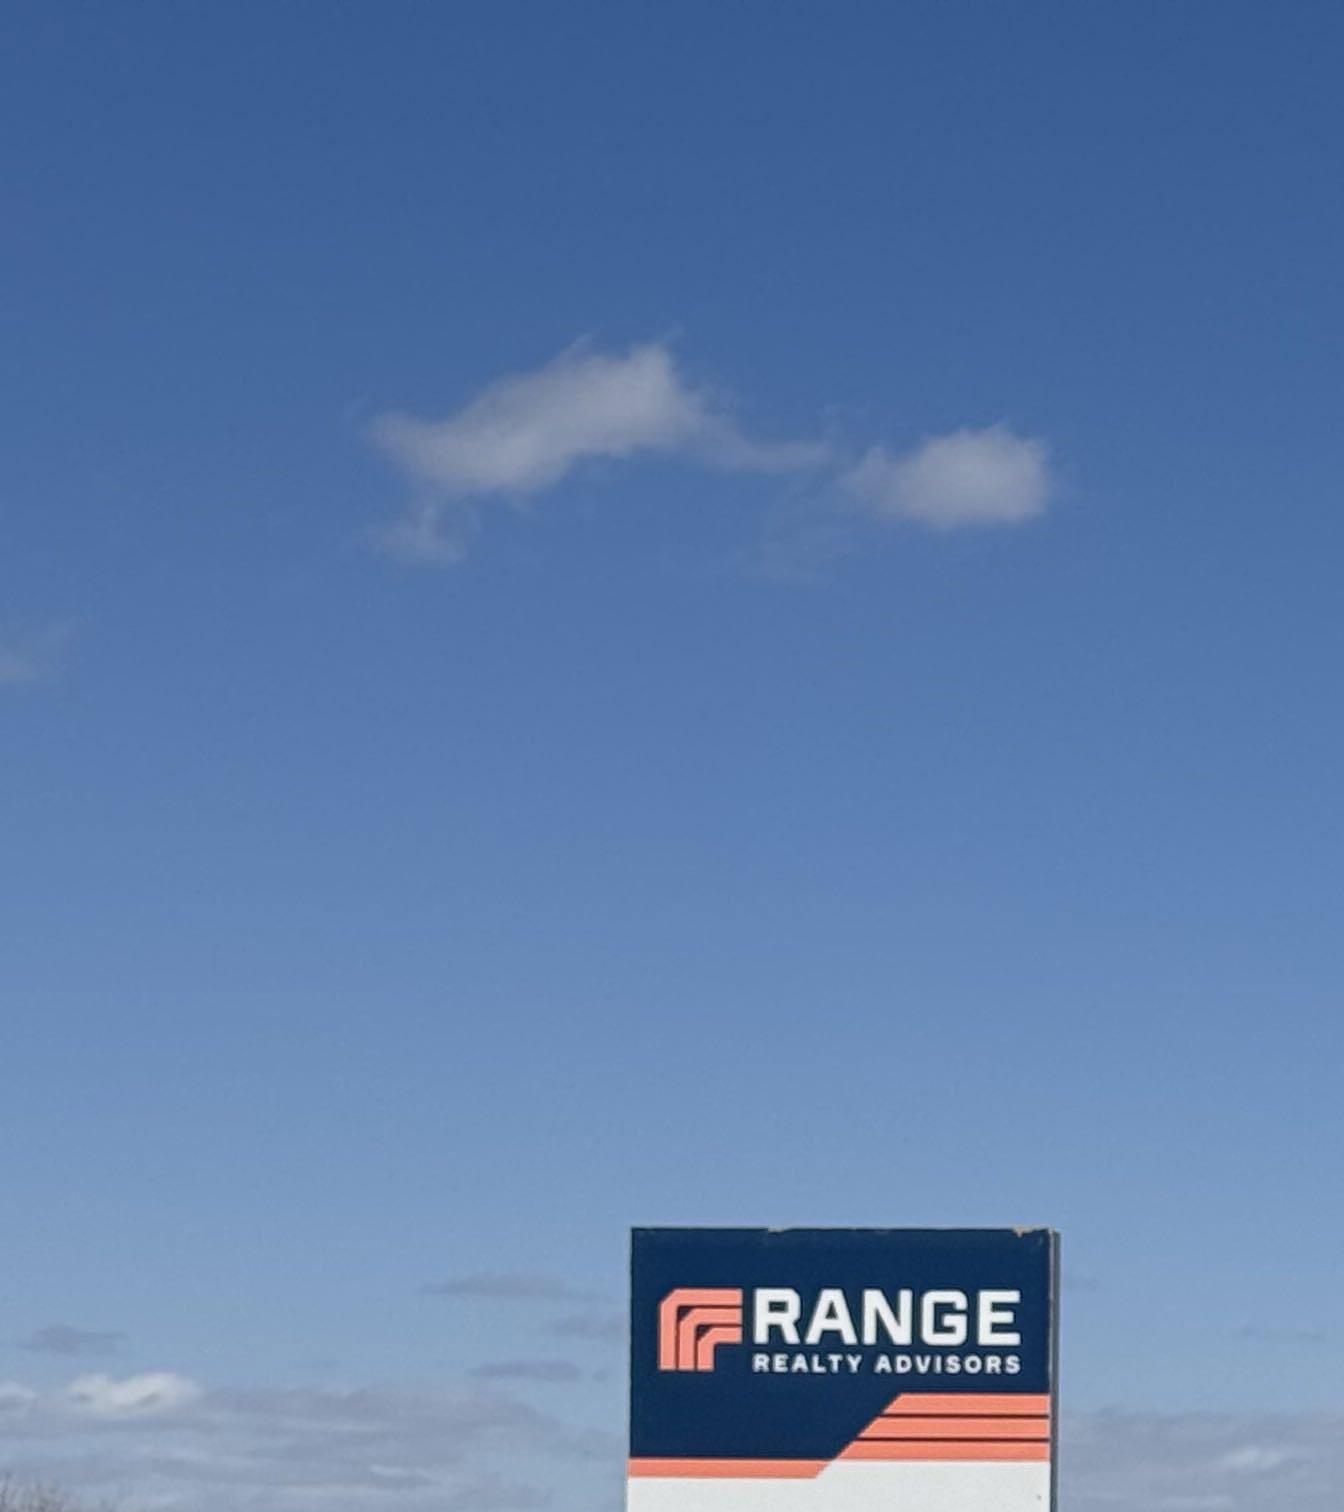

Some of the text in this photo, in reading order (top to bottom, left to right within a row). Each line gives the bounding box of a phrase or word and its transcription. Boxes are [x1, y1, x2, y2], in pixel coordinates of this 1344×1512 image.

[753, 1287, 1022, 1346] RANGE
[752, 1353, 1022, 1375] REALTY ADVISORS
